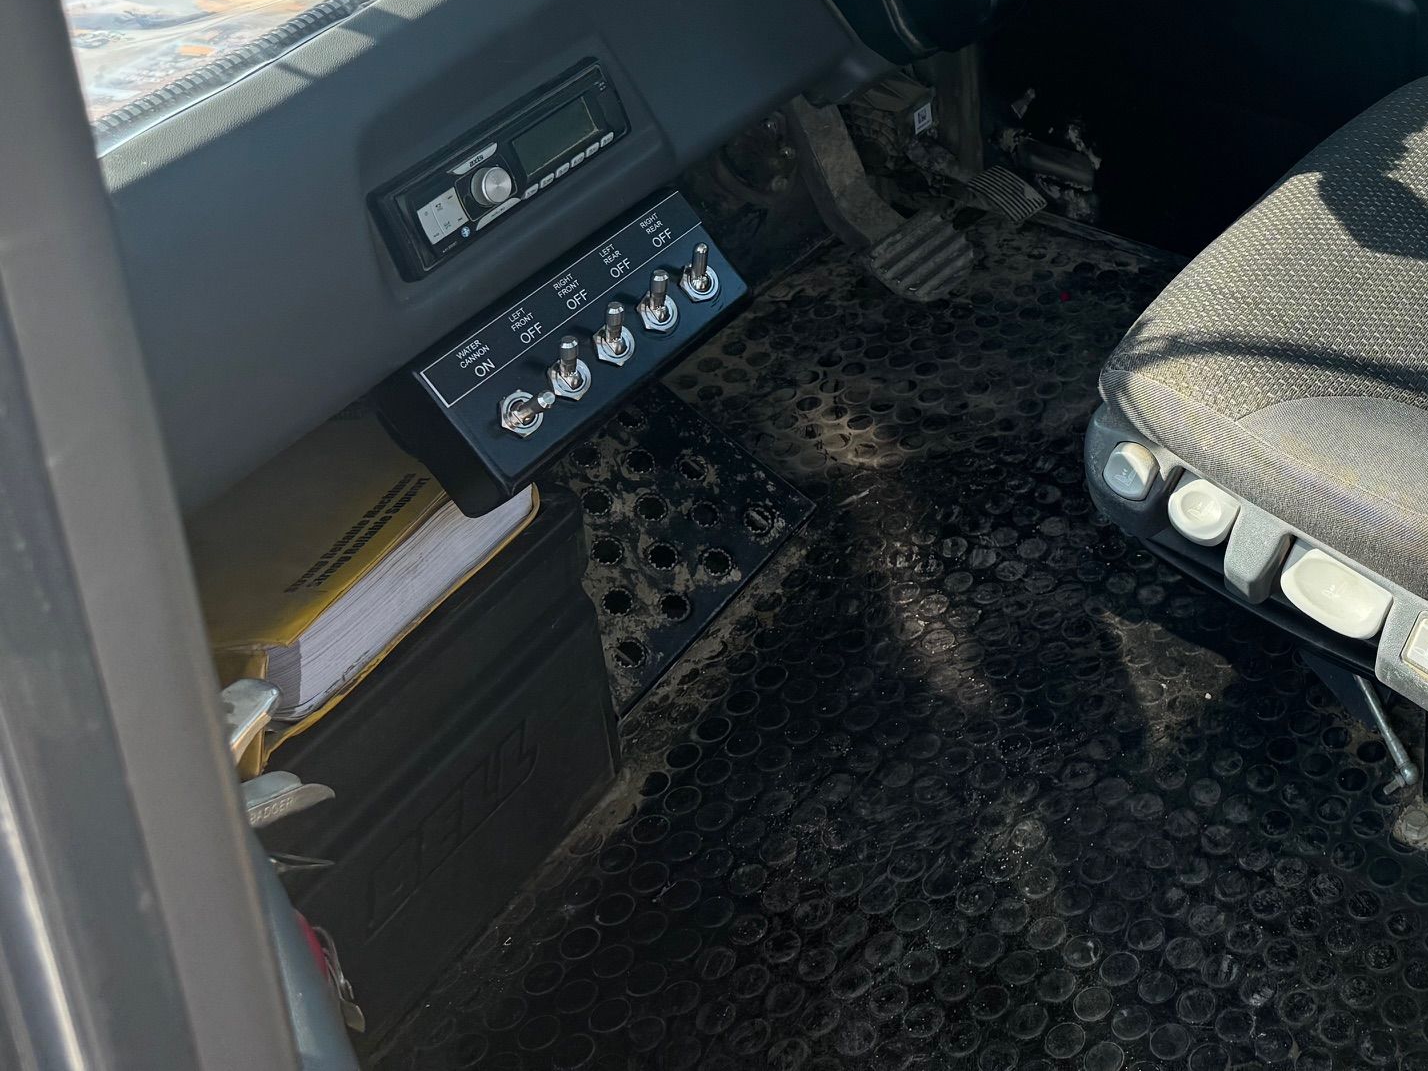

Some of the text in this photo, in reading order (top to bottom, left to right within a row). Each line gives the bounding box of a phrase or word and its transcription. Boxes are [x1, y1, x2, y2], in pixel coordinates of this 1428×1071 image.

[640, 213, 658, 229] RIGHT
[645, 220, 663, 235] REAR
[652, 228, 672, 248] OFF
[599, 243, 615, 258] LEFT
[603, 250, 622, 265] REAR
[610, 258, 631, 278] OFF
[552, 273, 574, 290] RIGHT
[557, 280, 580, 299] FRONT
[566, 289, 588, 310] OFF
[508, 307, 527, 323] LEFT
[511, 312, 534, 332] FRONT
[520, 322, 543, 344] OFF
[455, 339, 482, 360] WATER
[460, 344, 490, 369] CANNON
[474, 358, 496, 377] ON
